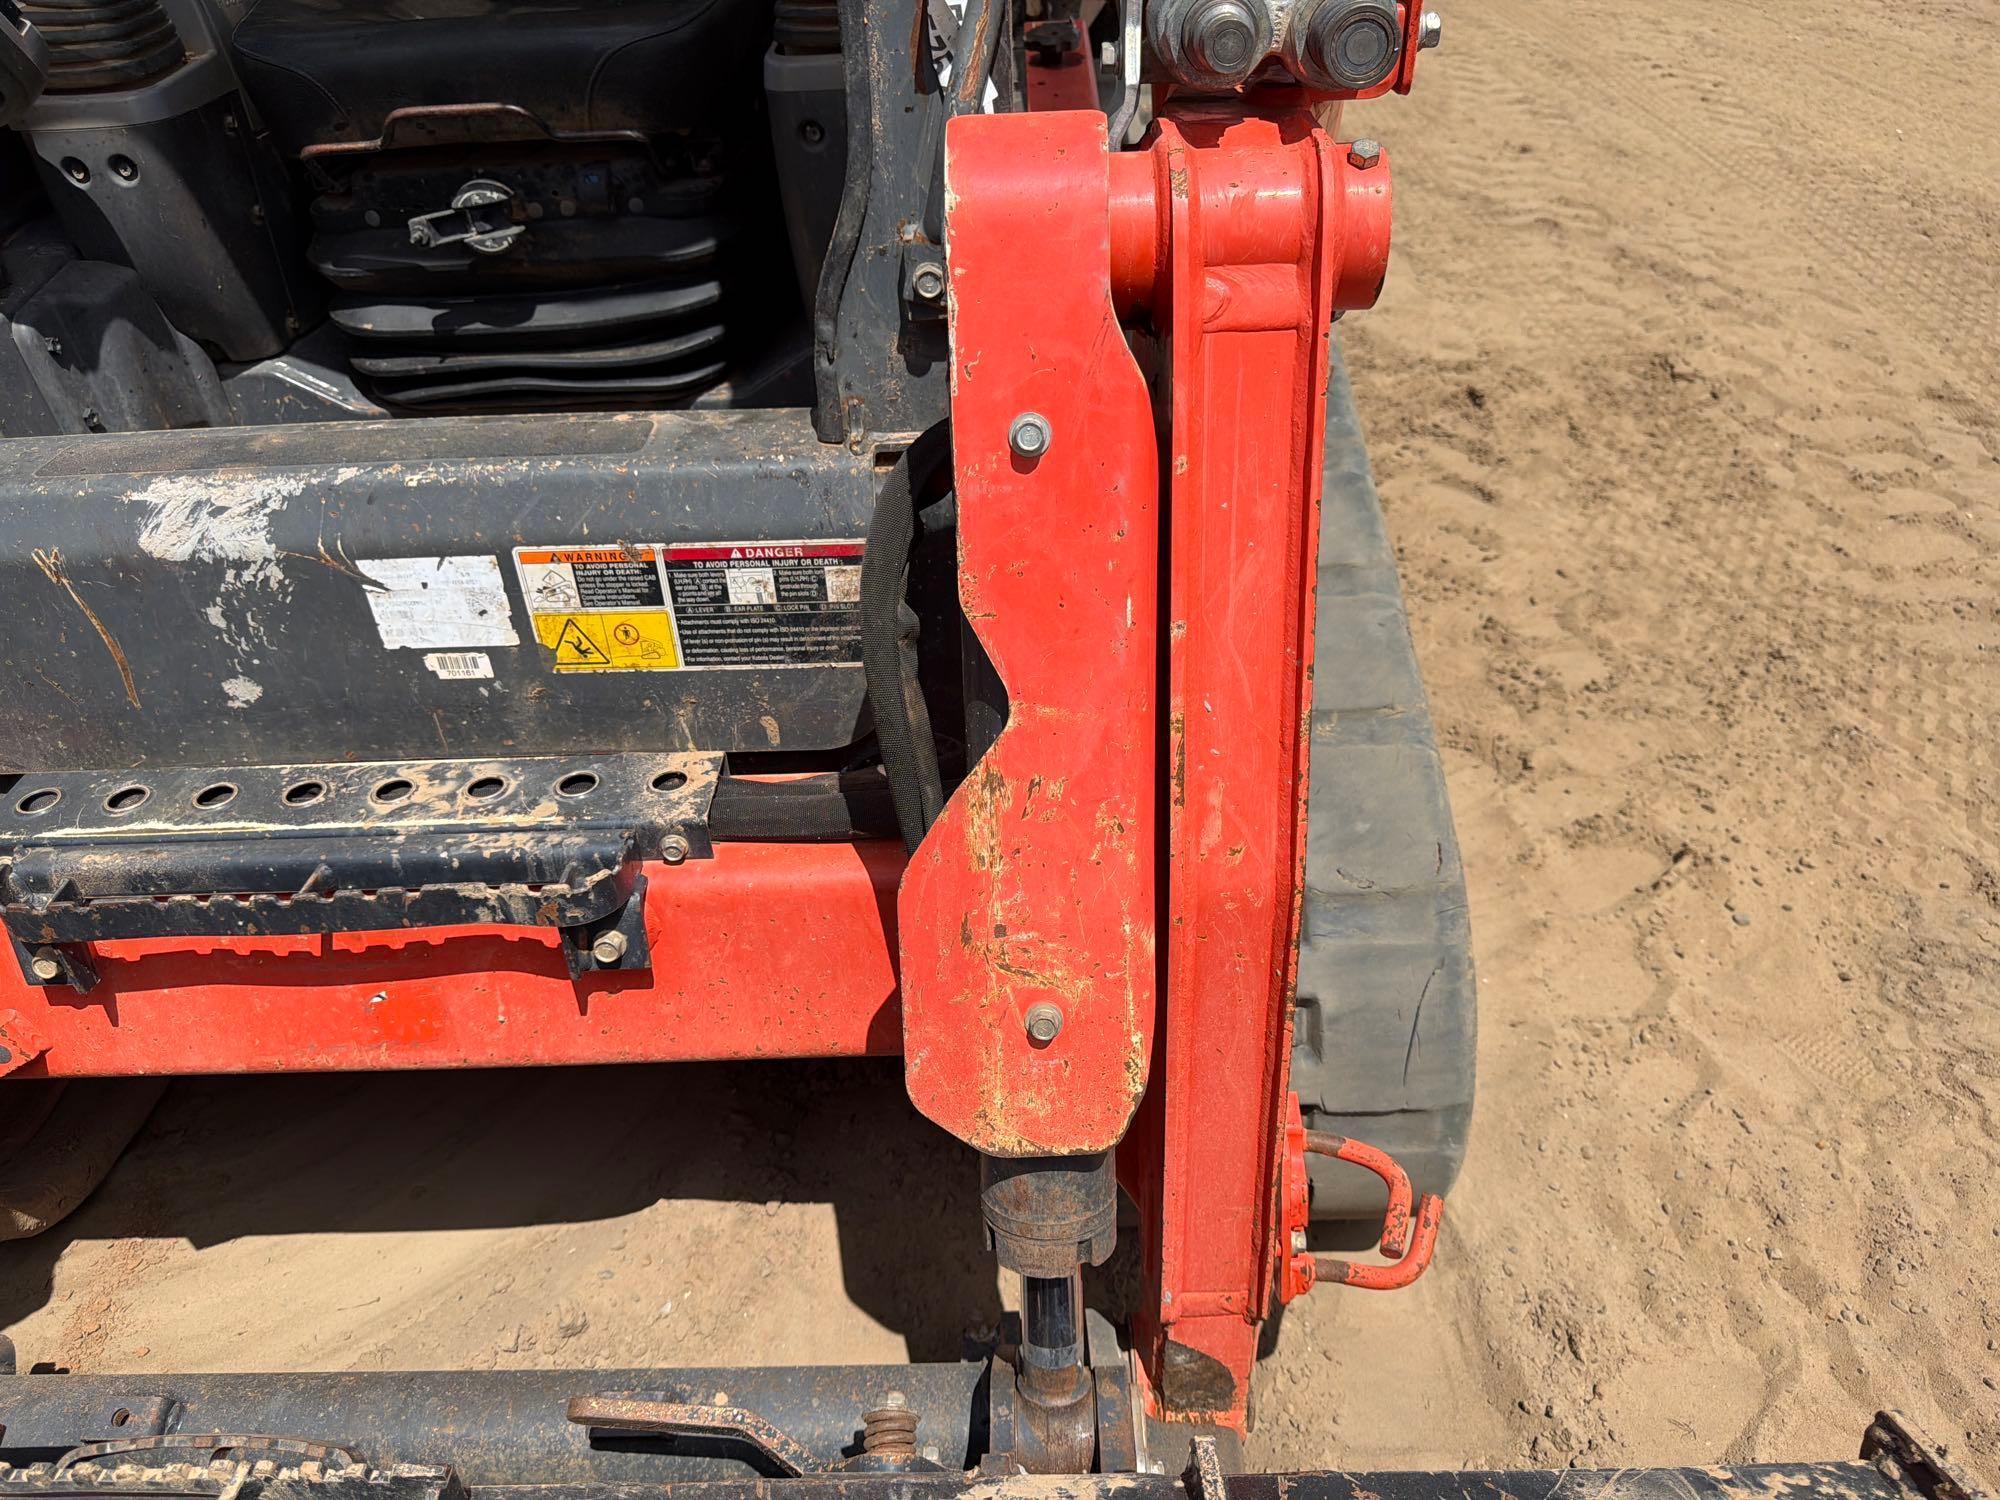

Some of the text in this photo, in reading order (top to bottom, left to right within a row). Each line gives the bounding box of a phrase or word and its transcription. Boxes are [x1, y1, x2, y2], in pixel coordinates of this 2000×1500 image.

[564, 552, 626, 562] WARNING
[745, 547, 804, 558] DANGER
[730, 560, 770, 568] PERSONAL
[800, 558, 812, 566] OR
